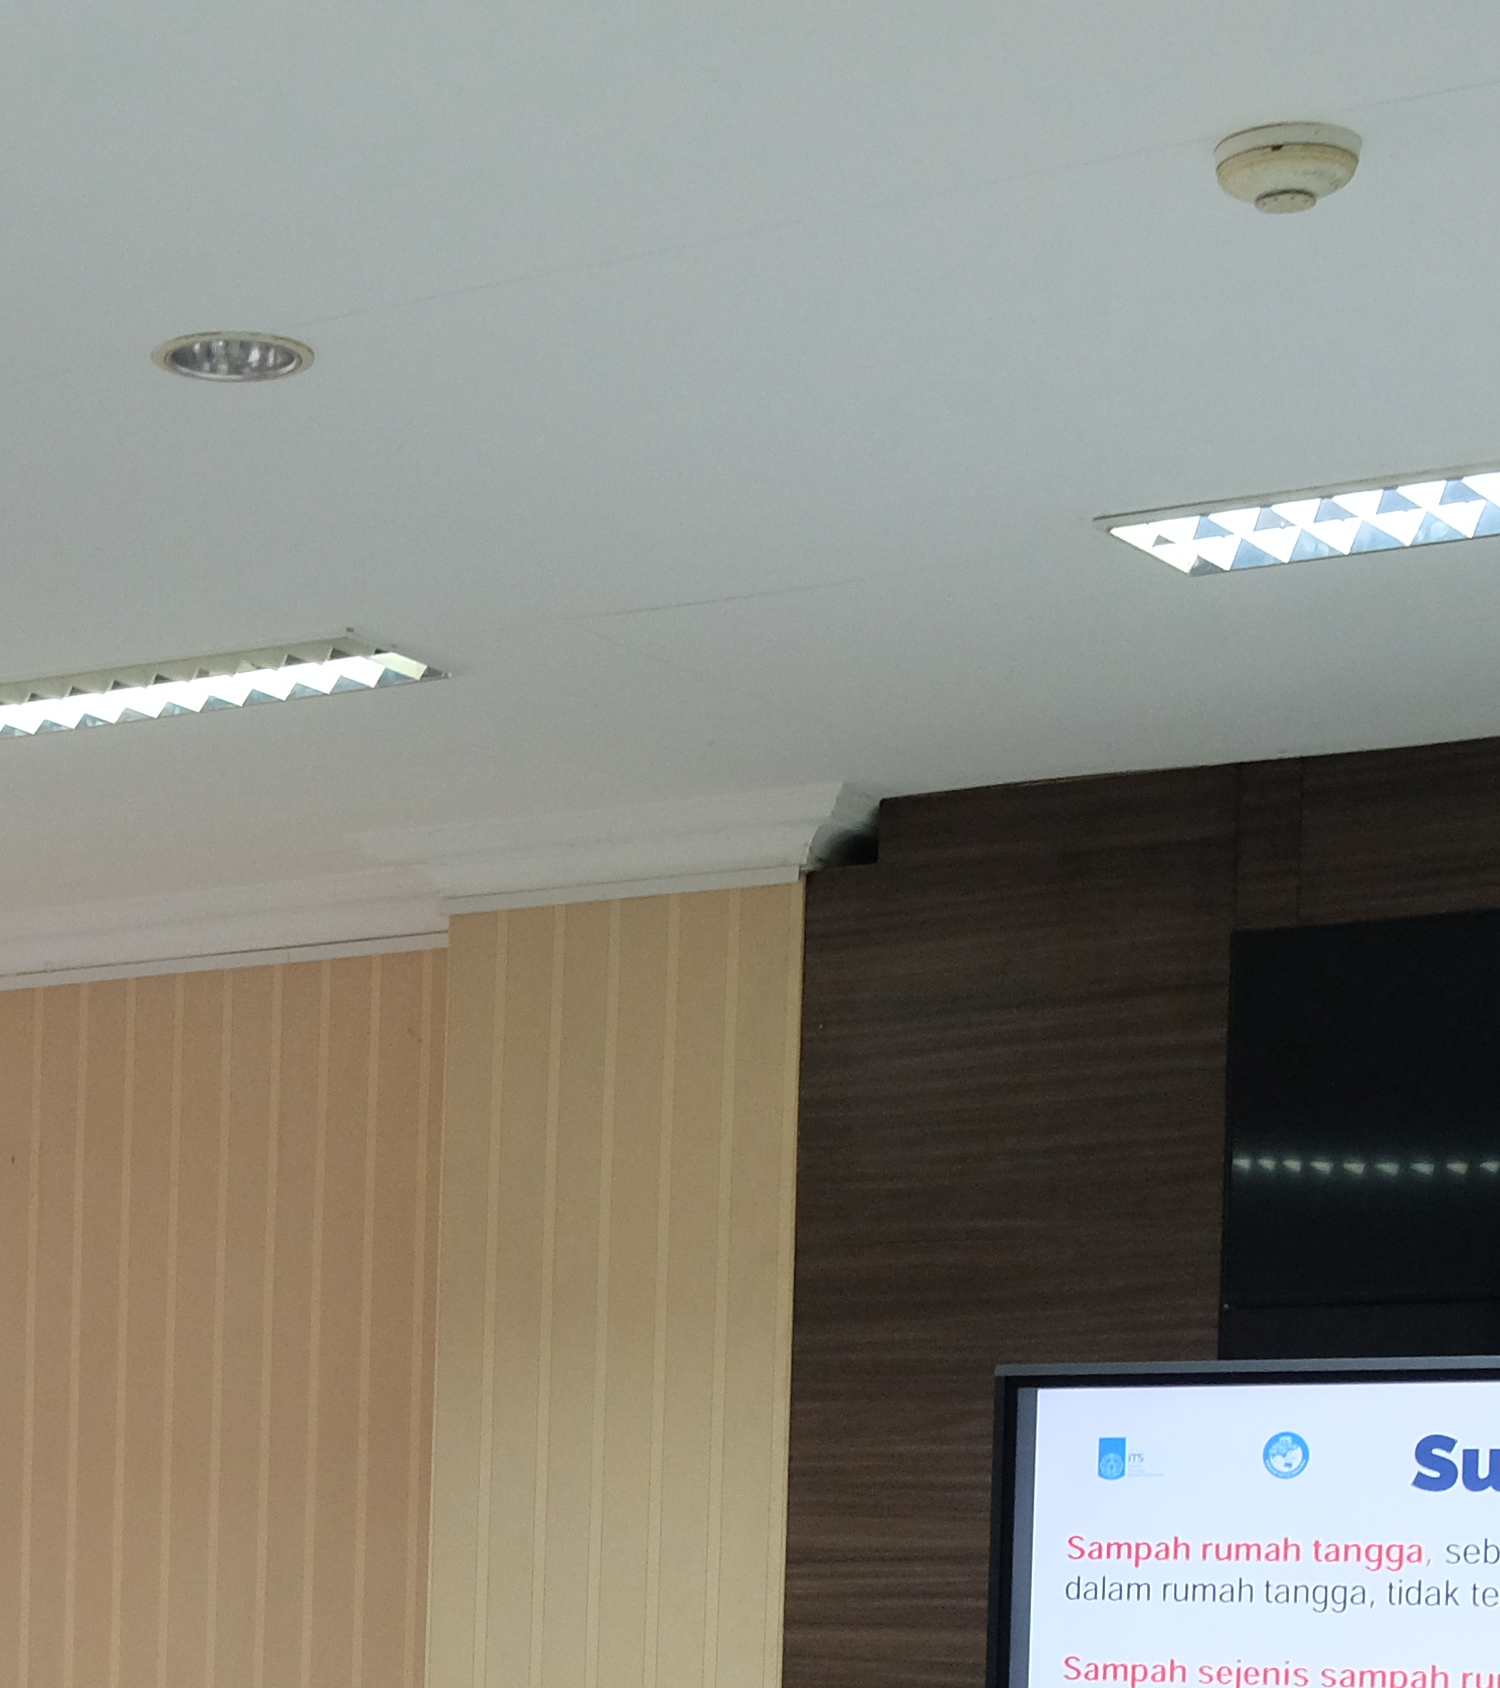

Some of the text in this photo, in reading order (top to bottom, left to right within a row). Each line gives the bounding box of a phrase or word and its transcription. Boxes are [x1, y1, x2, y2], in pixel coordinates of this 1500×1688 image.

[1067, 1536, 1191, 1568] Sampah
[1201, 1538, 1301, 1561] rumah
[1313, 1540, 1432, 1571] tangga,
[1065, 1575, 1151, 1601] dalam
[1162, 1577, 1253, 1603] rumah
[1265, 1580, 1375, 1613] tangga,
[1387, 1579, 1460, 1606] tidak
[1063, 1656, 1188, 1688] Sampah
